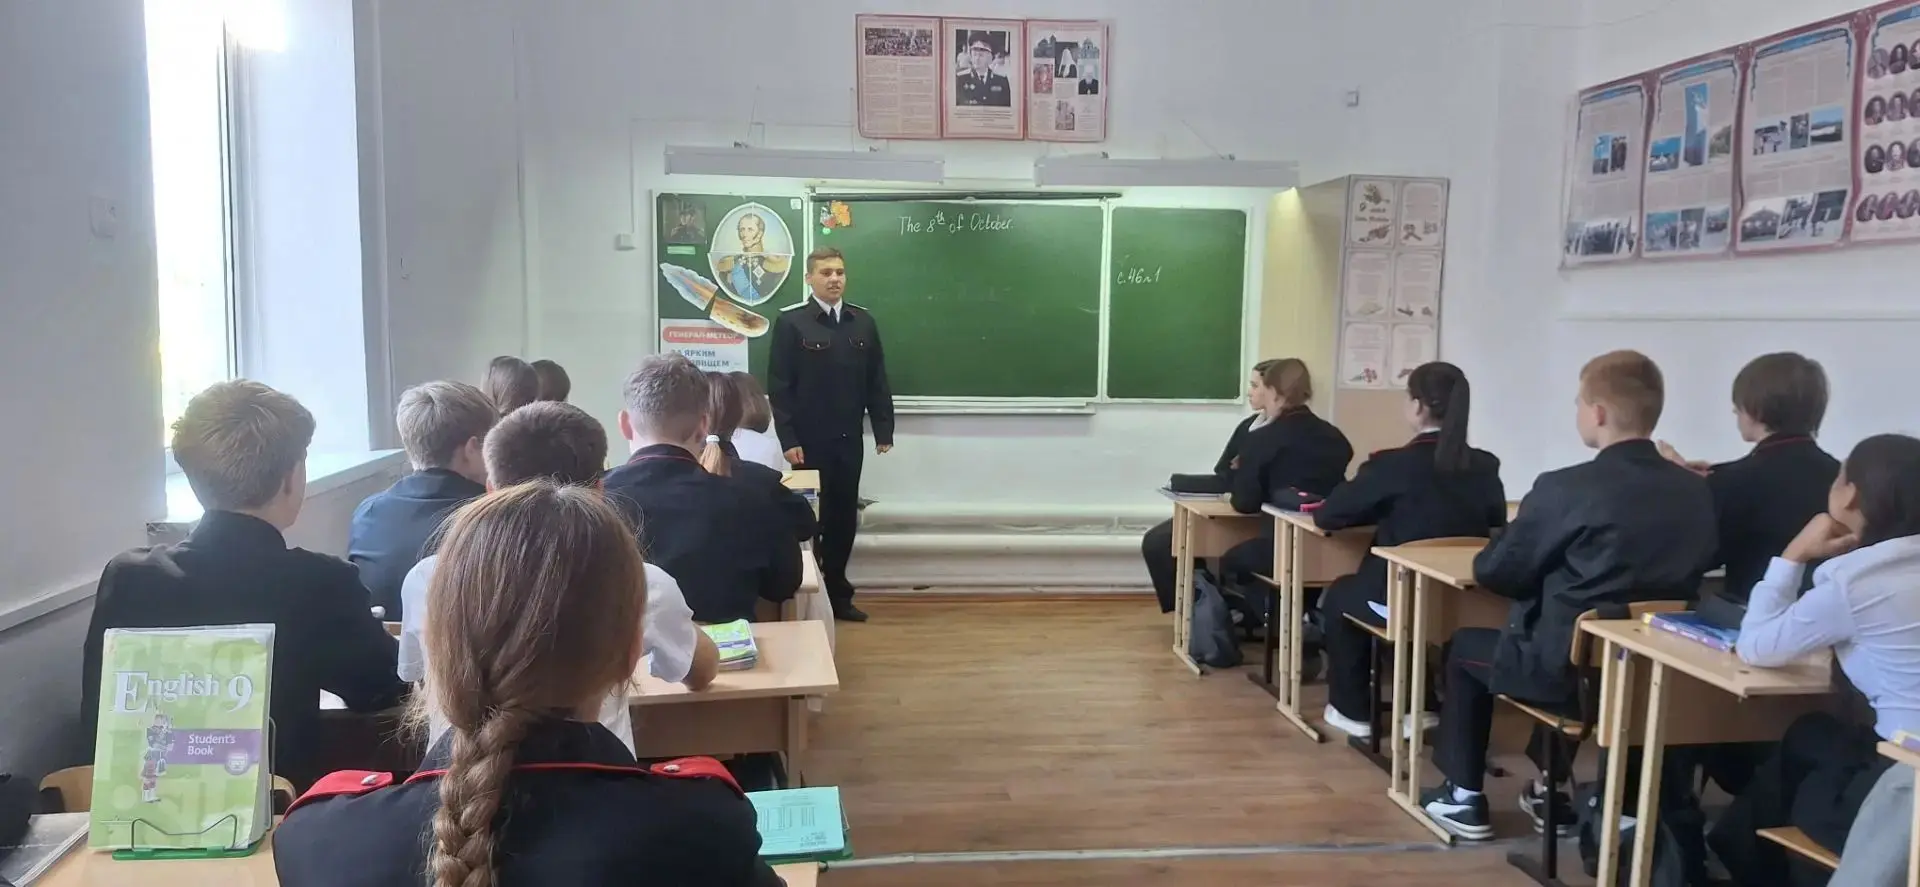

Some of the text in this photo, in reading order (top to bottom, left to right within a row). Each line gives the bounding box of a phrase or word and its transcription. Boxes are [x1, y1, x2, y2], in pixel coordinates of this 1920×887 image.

[898, 215, 921, 235] The
[949, 213, 964, 234] of
[684, 349, 715, 357] ЯРКИМ
[109, 671, 253, 713] English 9
[188, 733, 236, 745] Student's
[187, 745, 214, 756] Book
